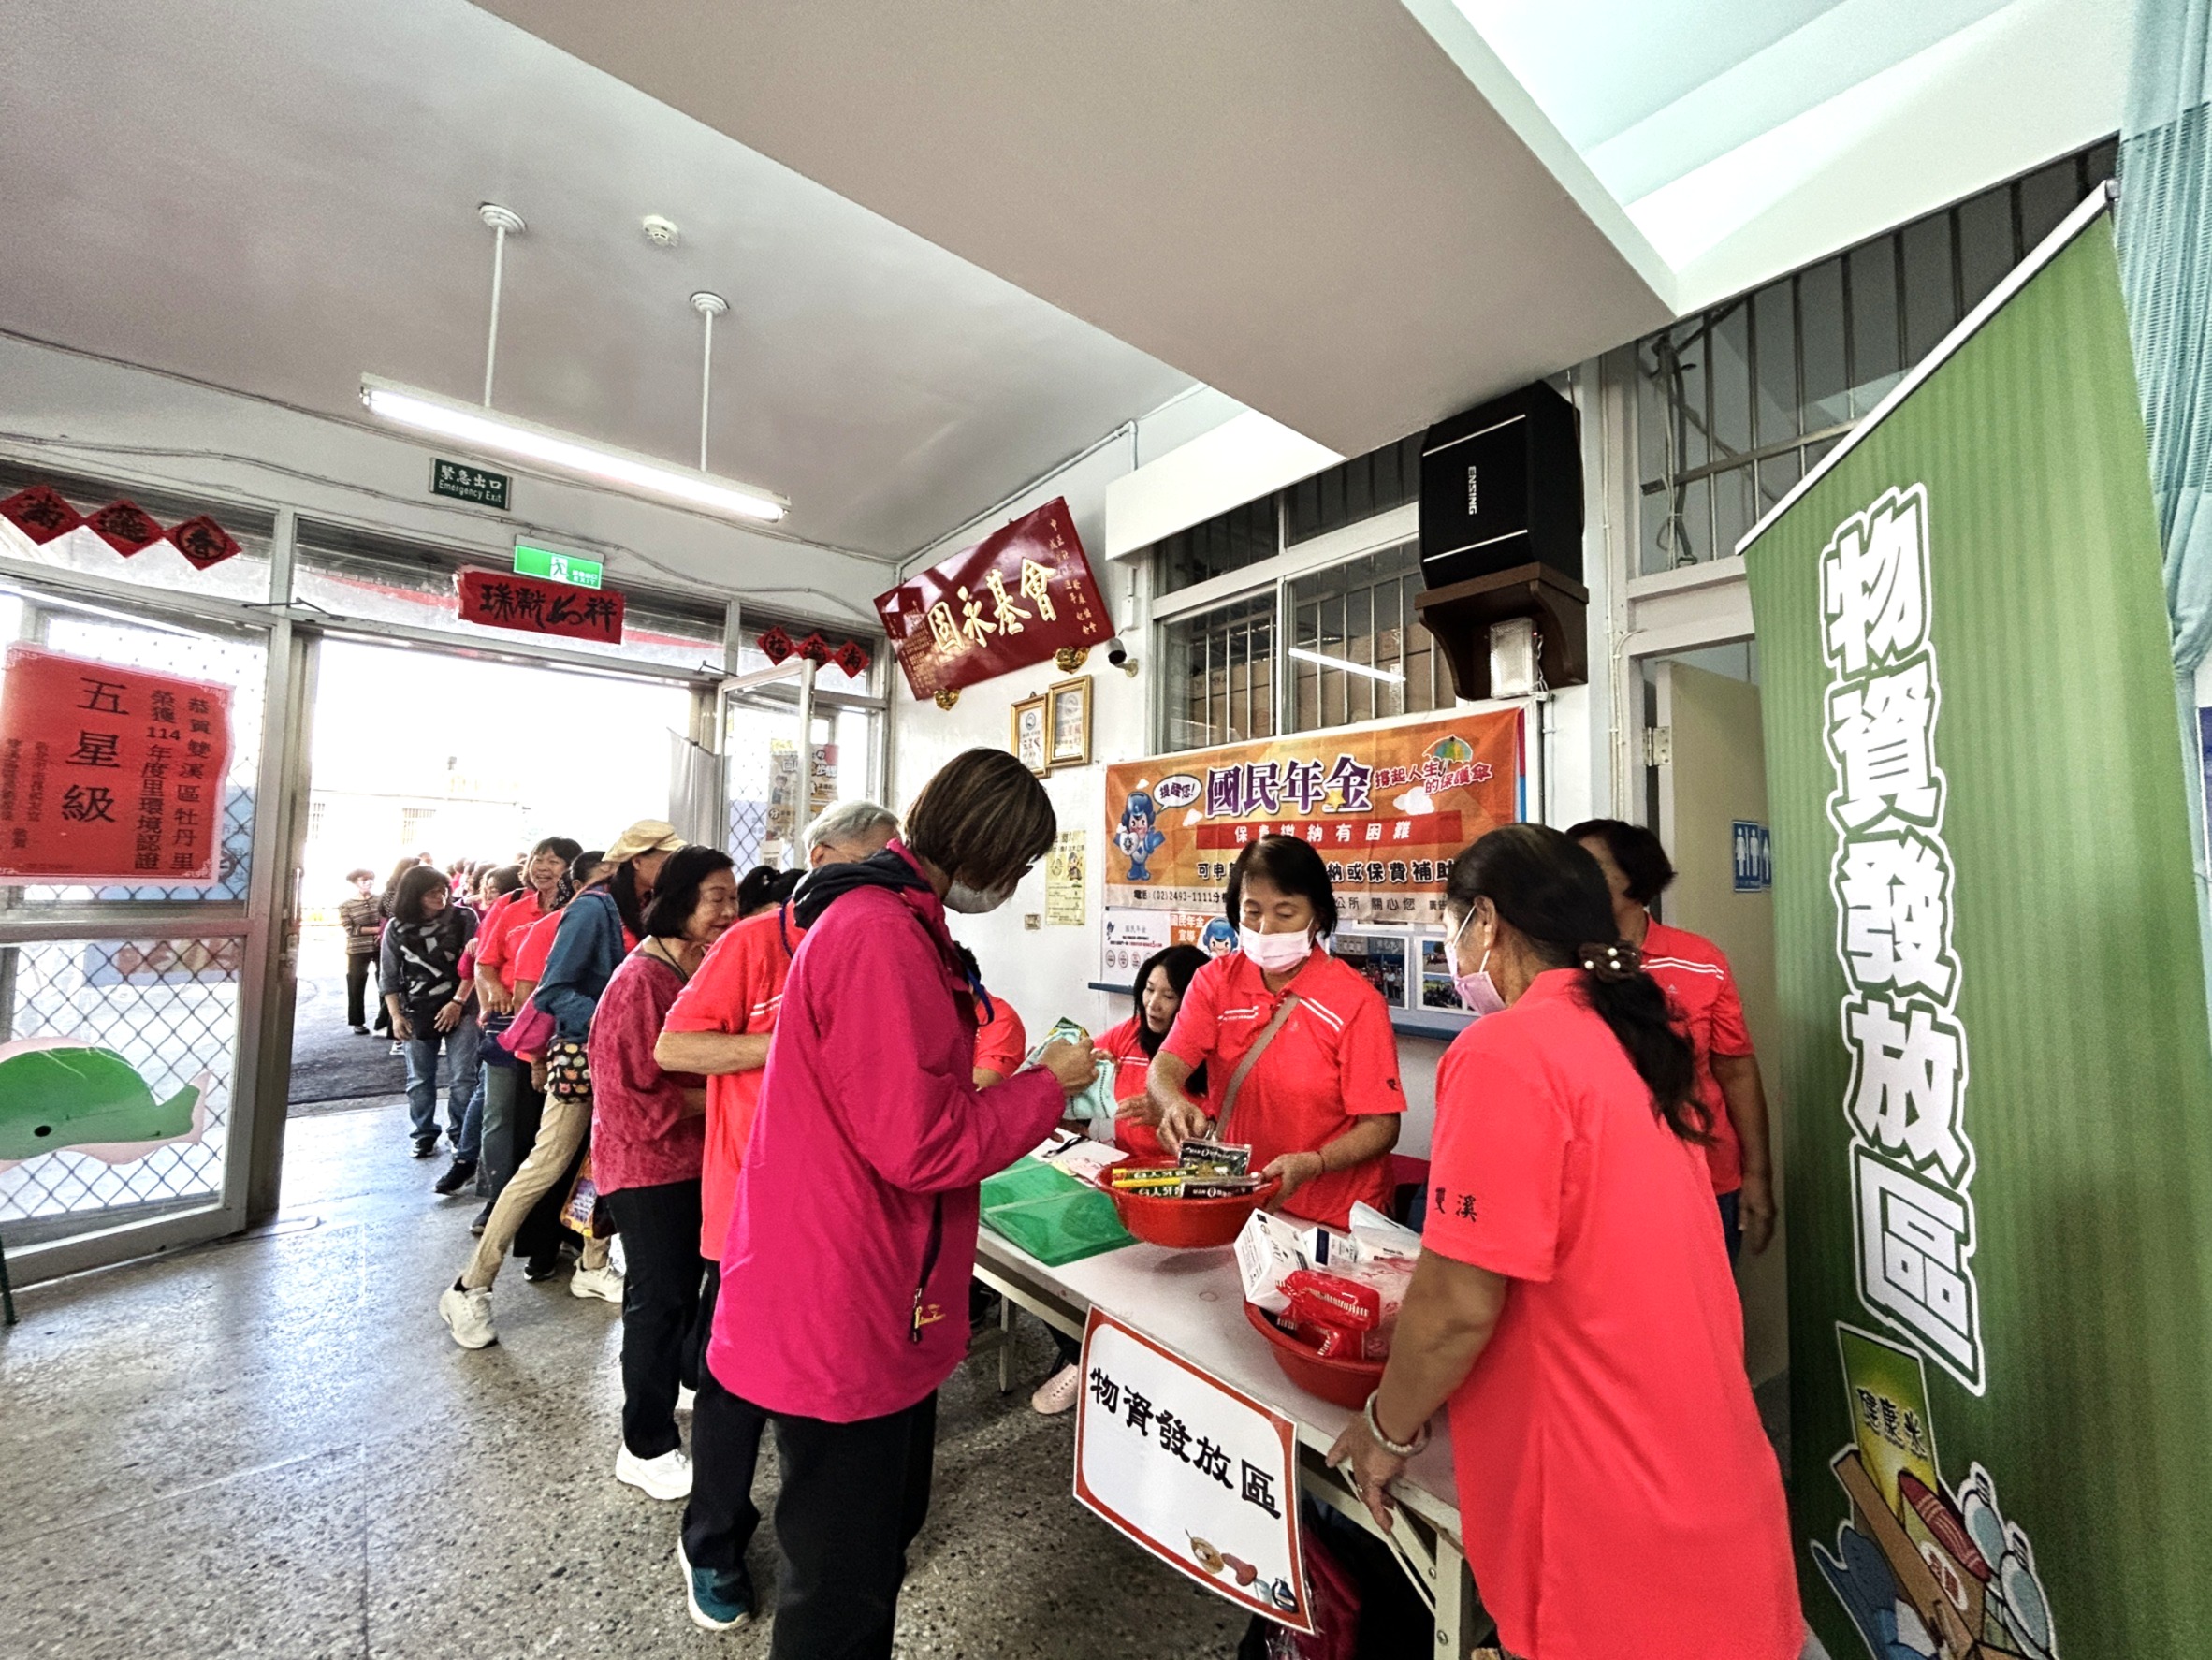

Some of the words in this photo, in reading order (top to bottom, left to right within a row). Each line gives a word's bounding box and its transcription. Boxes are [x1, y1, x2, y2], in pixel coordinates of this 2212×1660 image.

[438, 478, 484, 501] Emergency
[485, 489, 502, 503] Exit
[441, 464, 502, 490] 緊急出口
[61, 676, 130, 824] 五星級
[1205, 754, 1374, 820] 國民年金
[1197, 862, 1235, 881] 可申
[1820, 483, 1986, 1396] 物資發放區
[1089, 1366, 1283, 1521] 物資發放區
